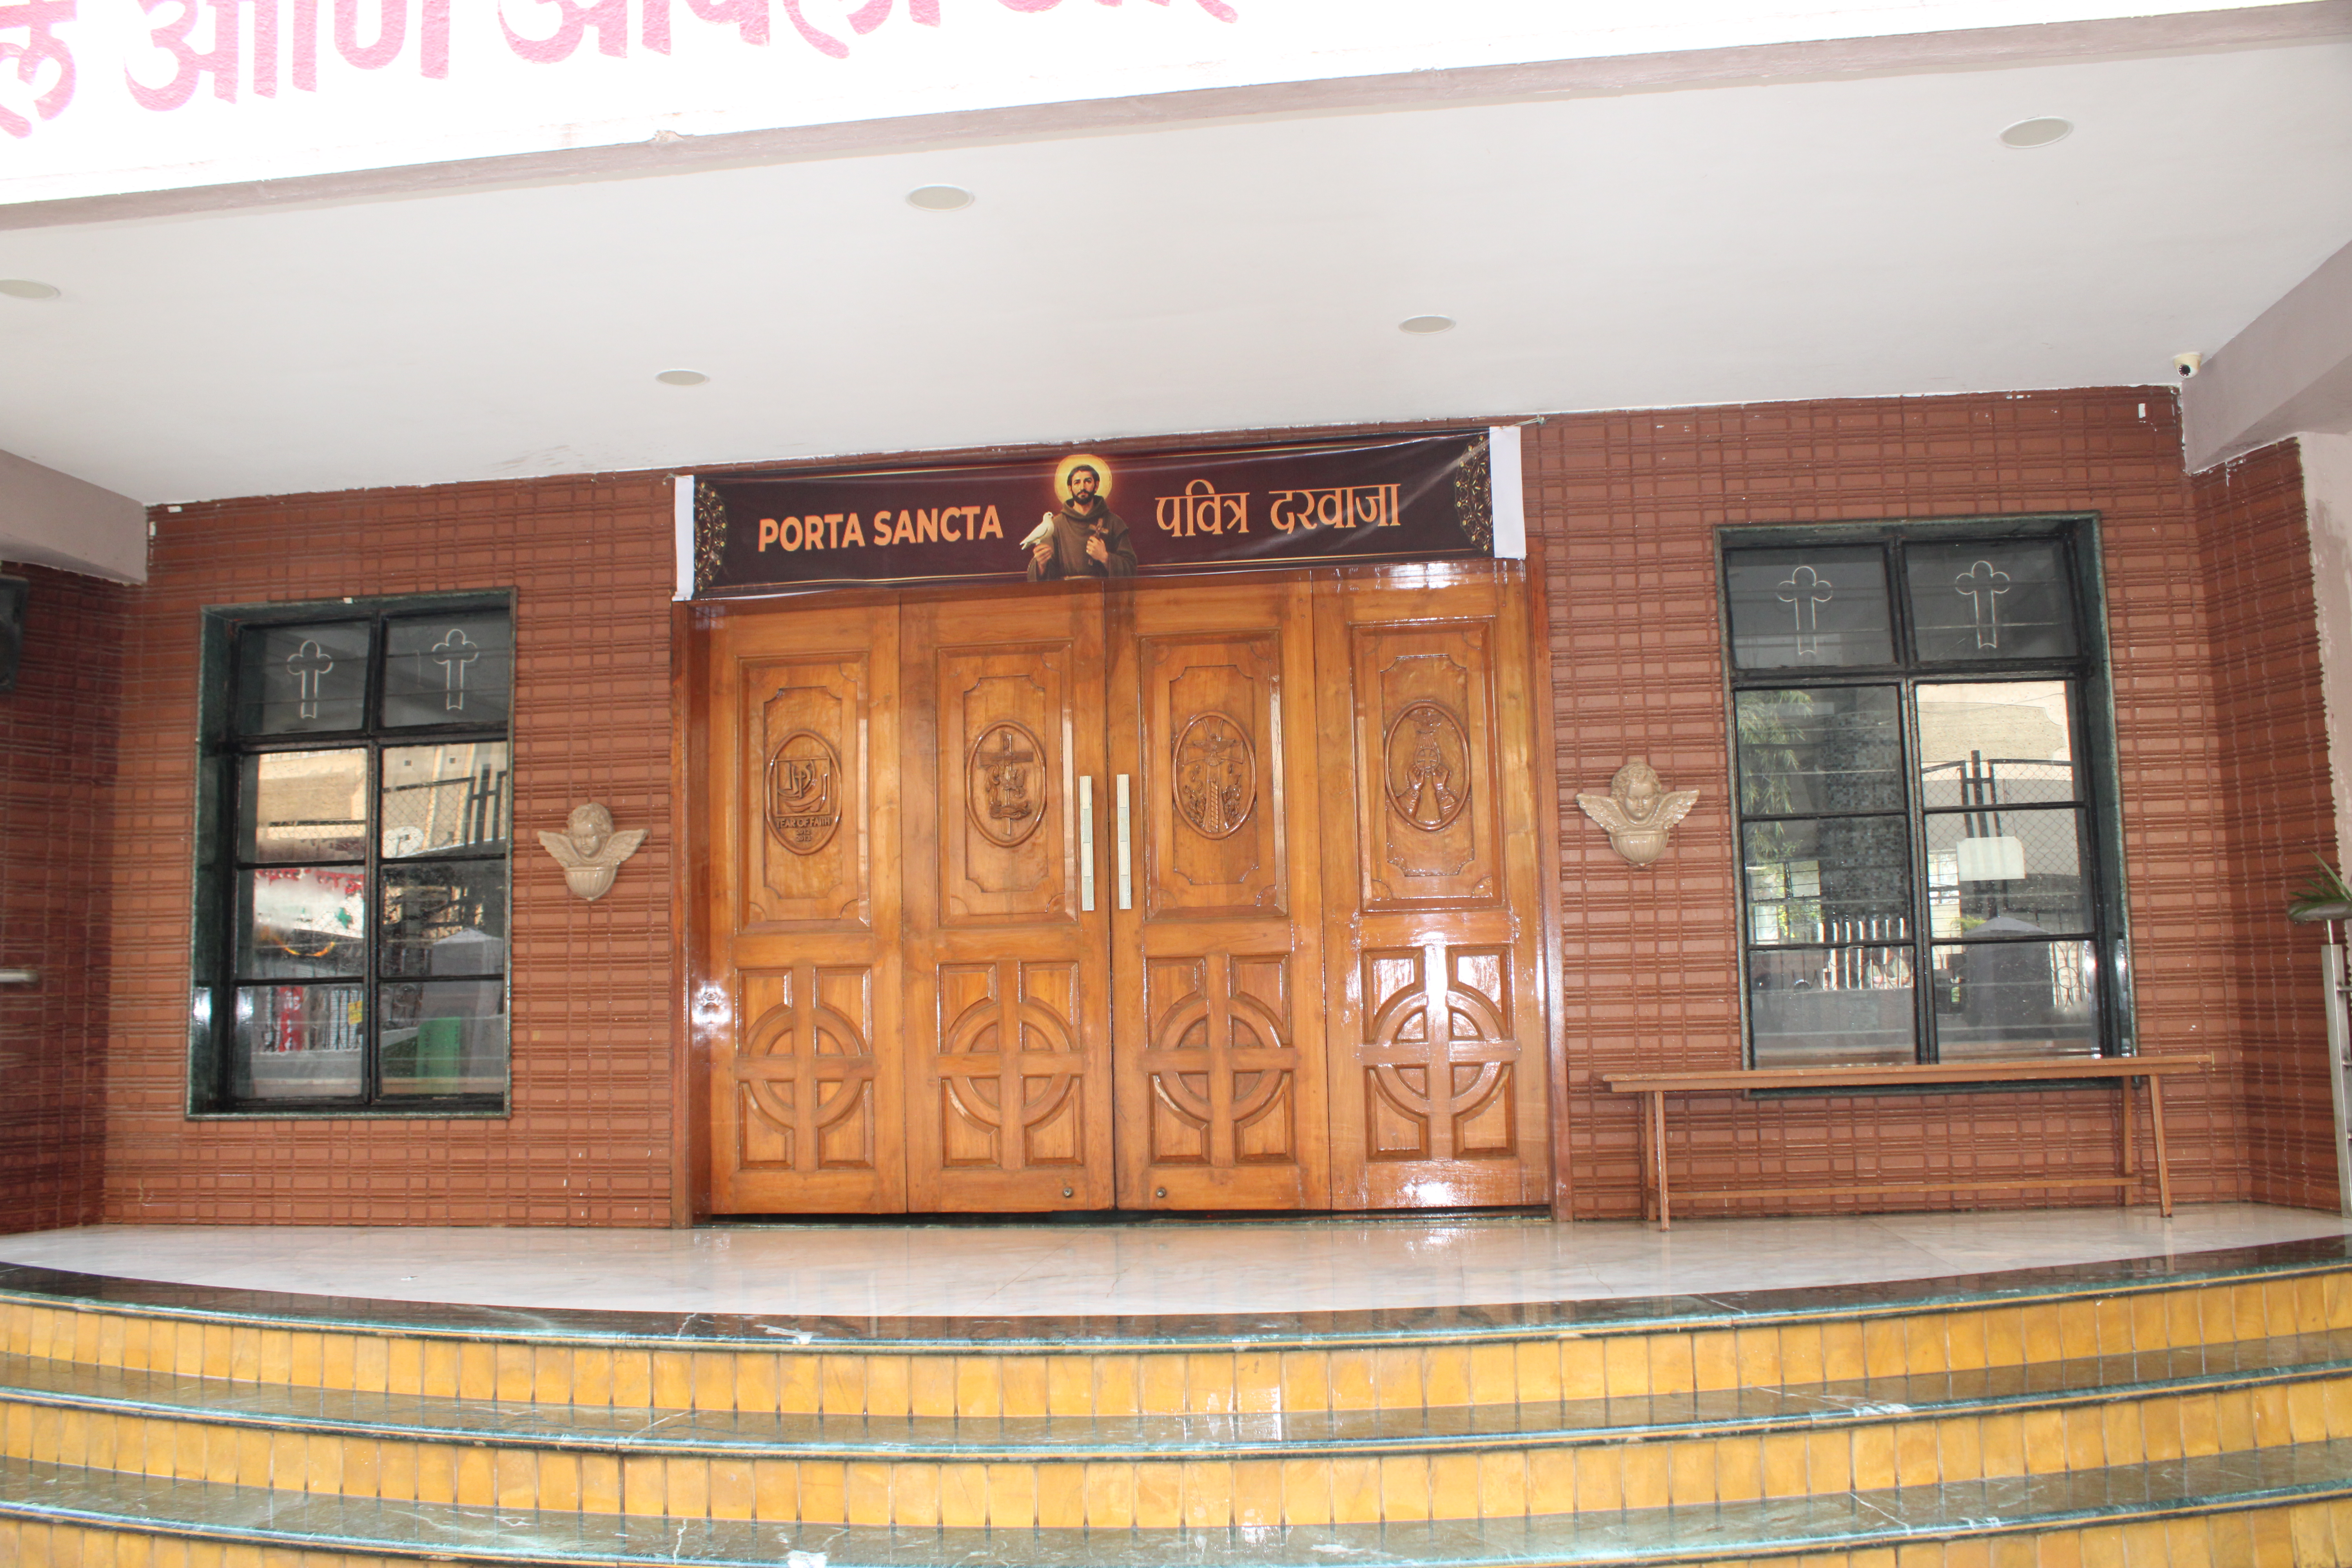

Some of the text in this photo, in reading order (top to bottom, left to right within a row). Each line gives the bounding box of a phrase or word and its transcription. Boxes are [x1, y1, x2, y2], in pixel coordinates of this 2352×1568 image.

[759, 505, 1004, 552] PORTA SANCTA
[1155, 479, 1401, 537] पवित्र दरवाजा
[797, 818, 809, 828] OF
[810, 817, 831, 826] FAITH
